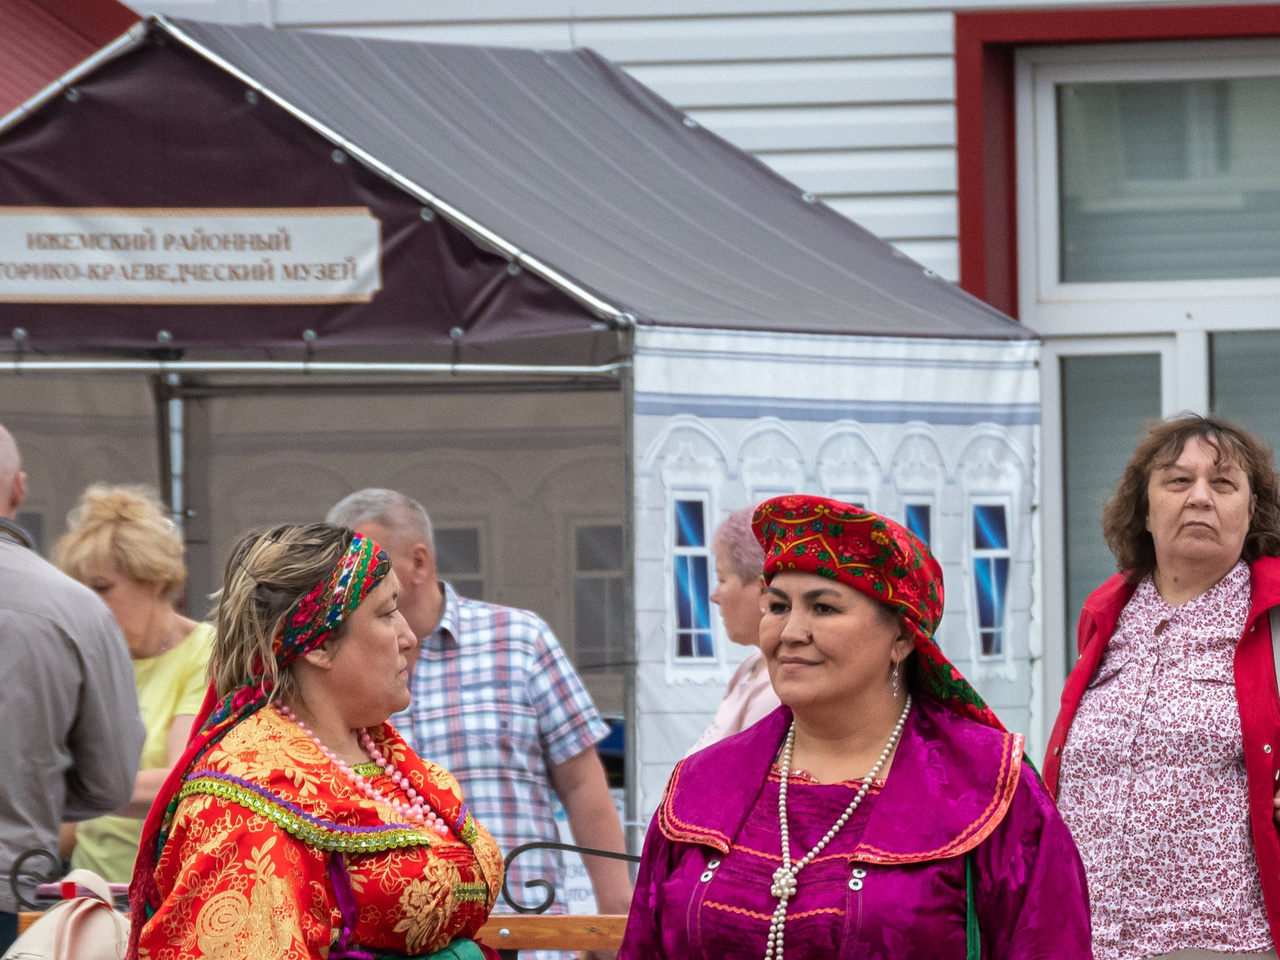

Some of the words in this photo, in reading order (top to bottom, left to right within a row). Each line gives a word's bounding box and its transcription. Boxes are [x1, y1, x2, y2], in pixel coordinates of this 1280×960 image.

[26, 227, 157, 251] ИЖЕМСКИЙ
[163, 226, 292, 252] РАЙОННЫЙ
[281, 256, 358, 282] МУЗЕЙ
